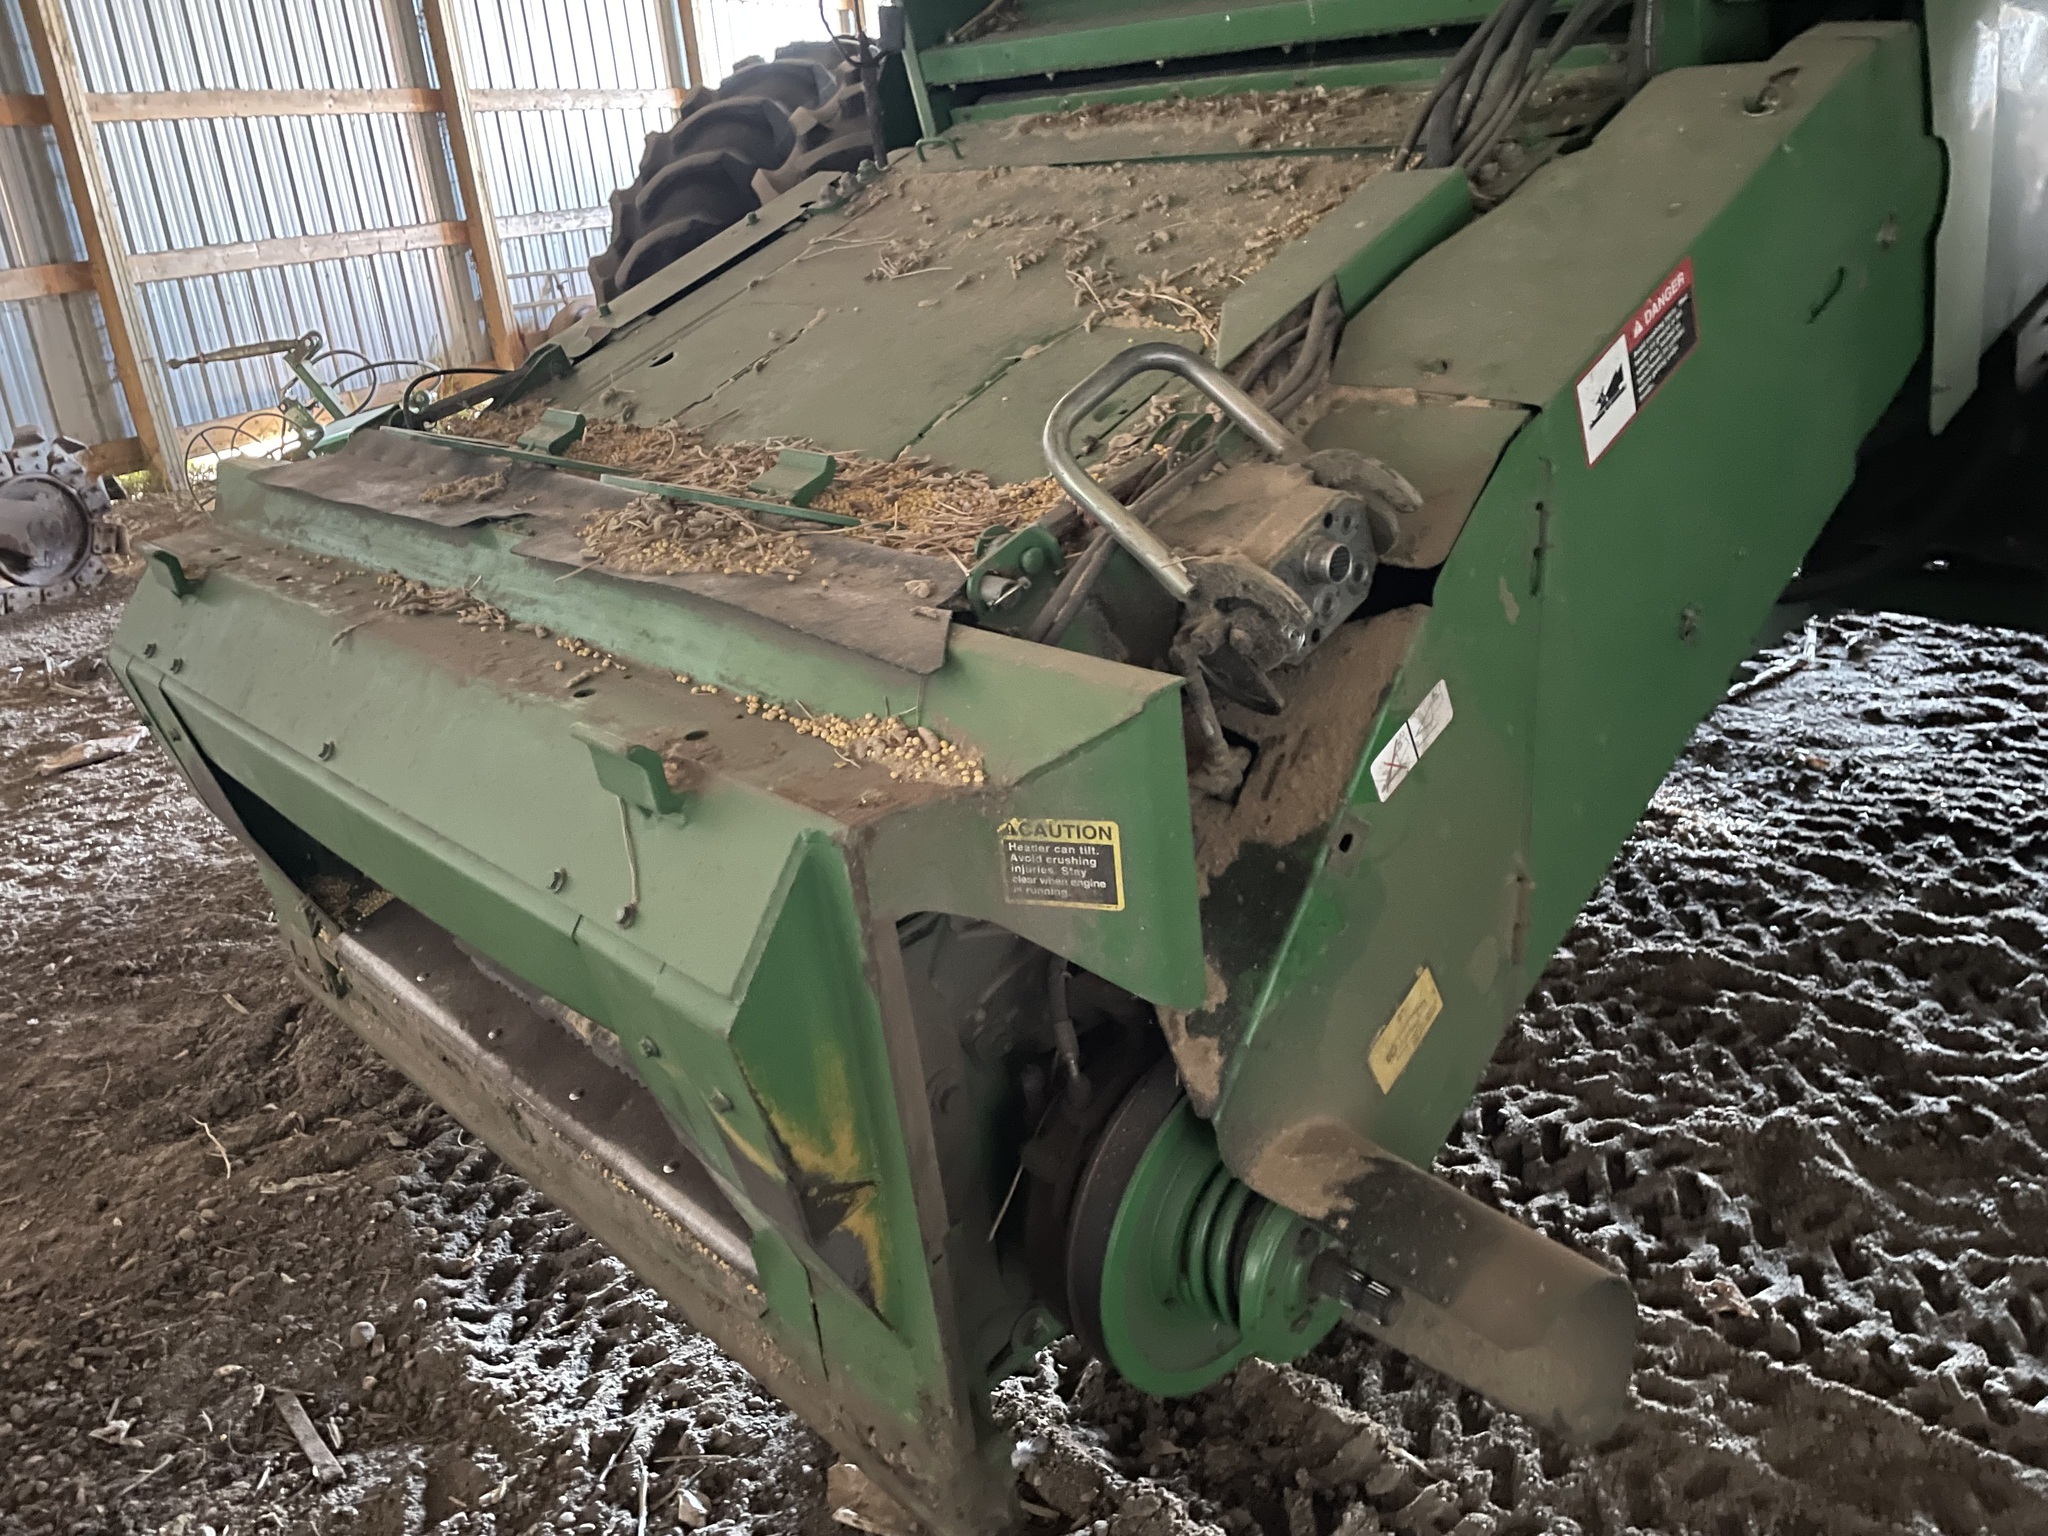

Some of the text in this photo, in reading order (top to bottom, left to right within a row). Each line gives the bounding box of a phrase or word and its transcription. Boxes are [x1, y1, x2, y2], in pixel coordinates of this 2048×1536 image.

[1644, 271, 1685, 326] DANGER
[1019, 822, 1112, 840] CAUTION
[1054, 845, 1075, 854] can
[1080, 845, 1099, 856] tilt.
[1010, 853, 1097, 868] Avoid crushing
[1061, 866, 1087, 878] Stay
[1012, 876, 1107, 889] clear when engine
